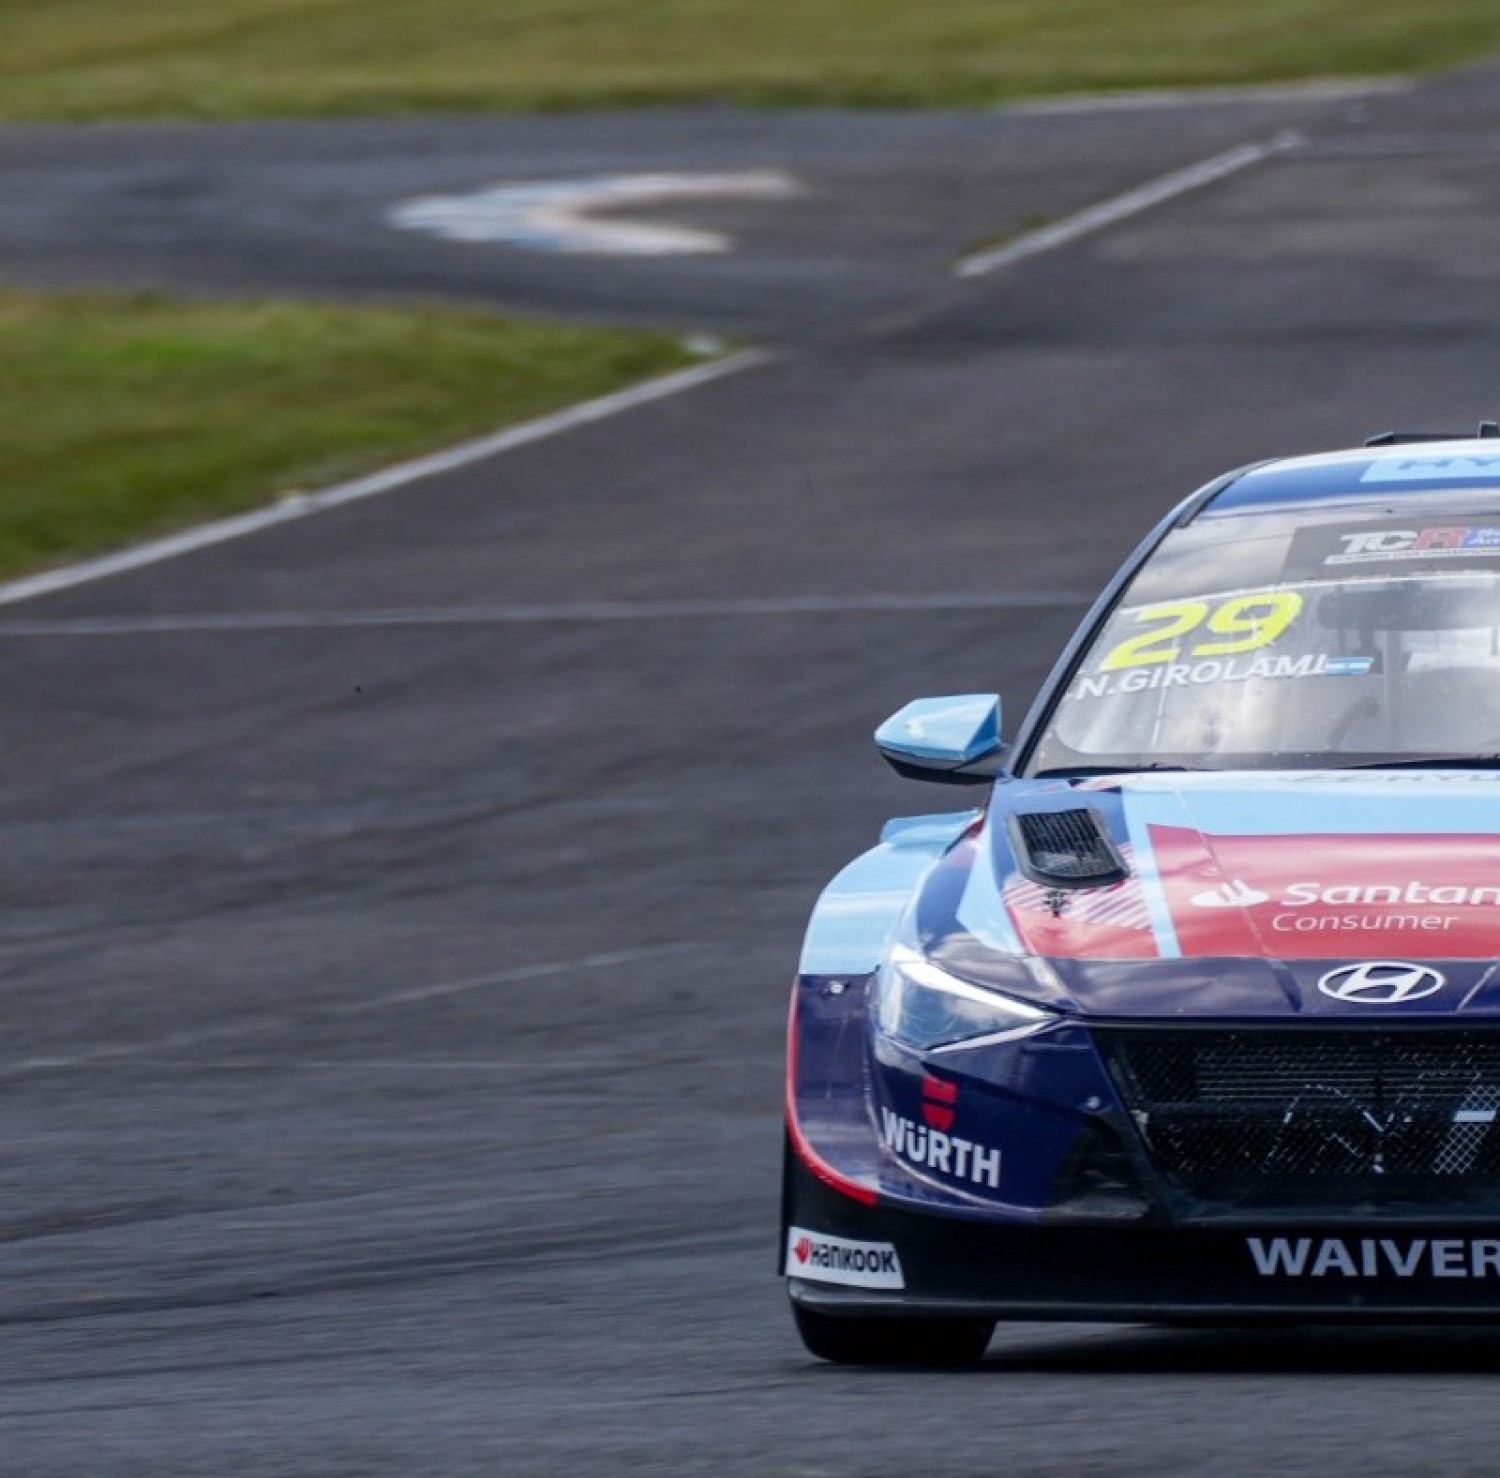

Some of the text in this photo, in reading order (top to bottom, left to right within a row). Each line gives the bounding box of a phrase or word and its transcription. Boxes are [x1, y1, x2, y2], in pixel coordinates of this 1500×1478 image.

[1339, 527, 1470, 554] TCR
[1100, 592, 1303, 671] 29
[1271, 912, 1460, 932] Consumer
[880, 1105, 1001, 1188] WÜRTH
